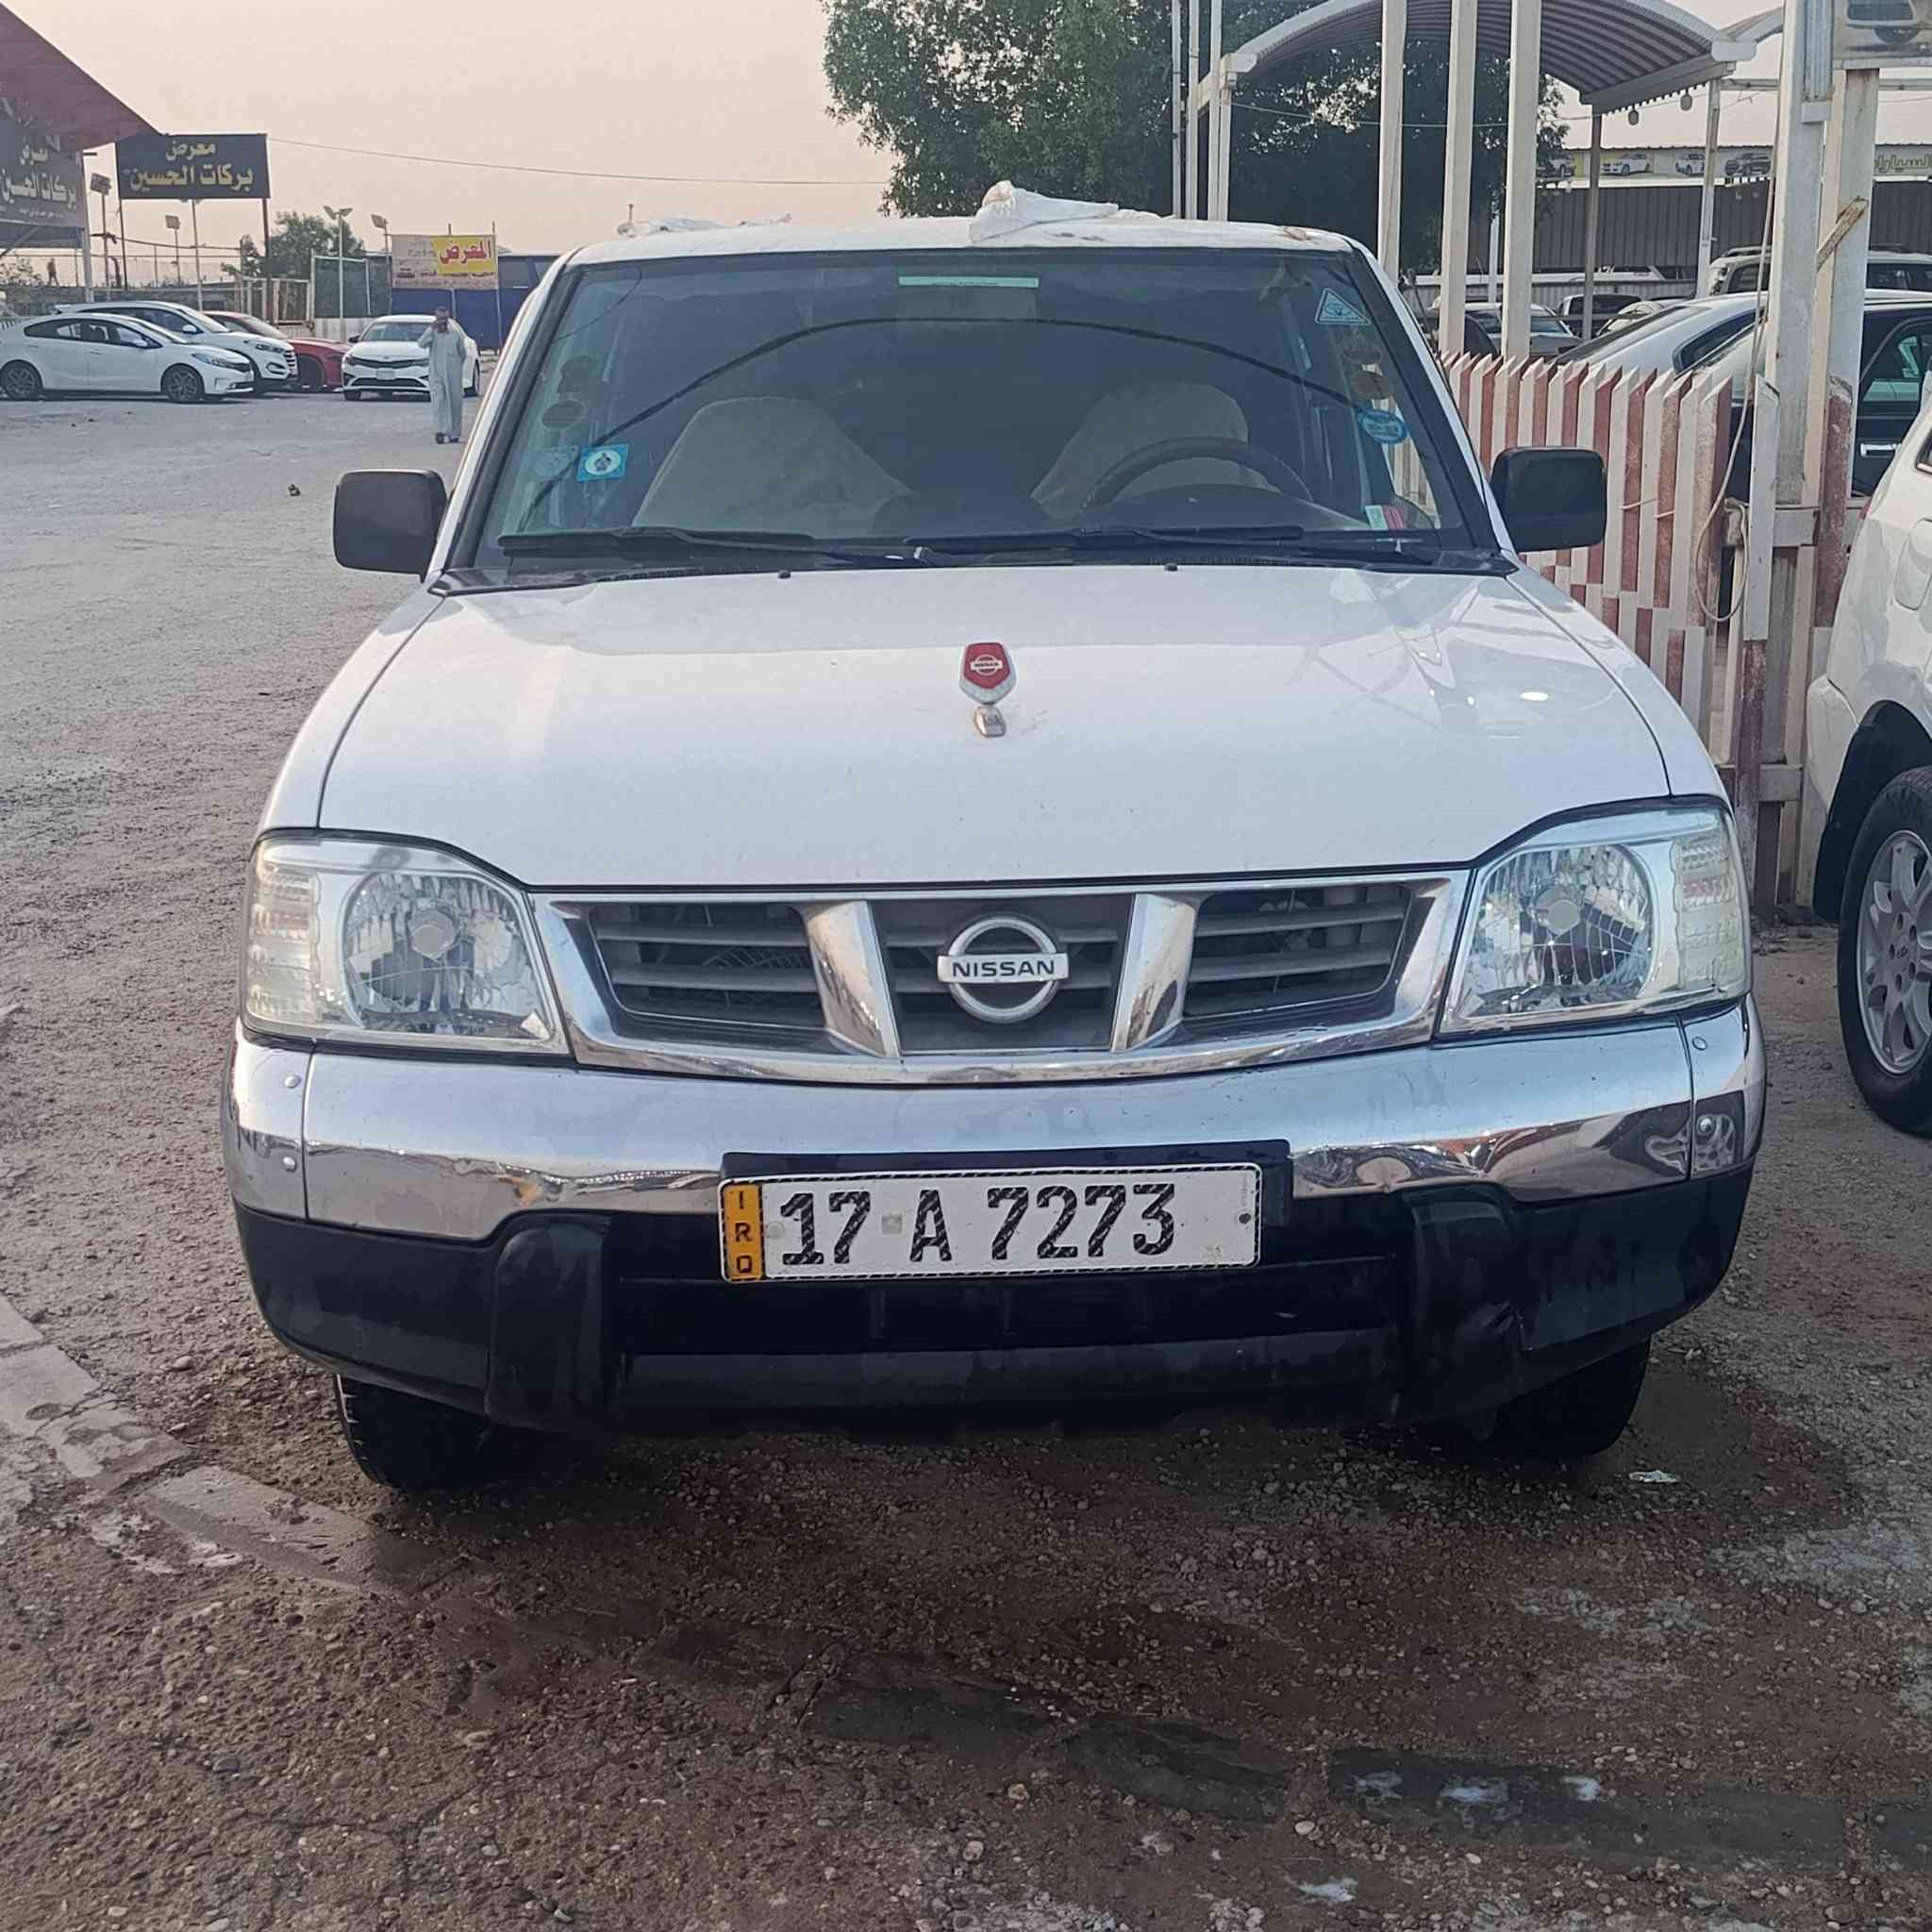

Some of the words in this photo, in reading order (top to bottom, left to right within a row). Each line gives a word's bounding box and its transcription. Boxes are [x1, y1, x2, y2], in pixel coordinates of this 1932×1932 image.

[166, 140, 216, 160] معرض
[130, 164, 194, 192] الحسين
[200, 163, 254, 192] بركات
[953, 960, 1055, 977] NISSAN
[779, 1189, 872, 1266] 17
[909, 1189, 953, 1262] A
[987, 1183, 1175, 1260] 7273
